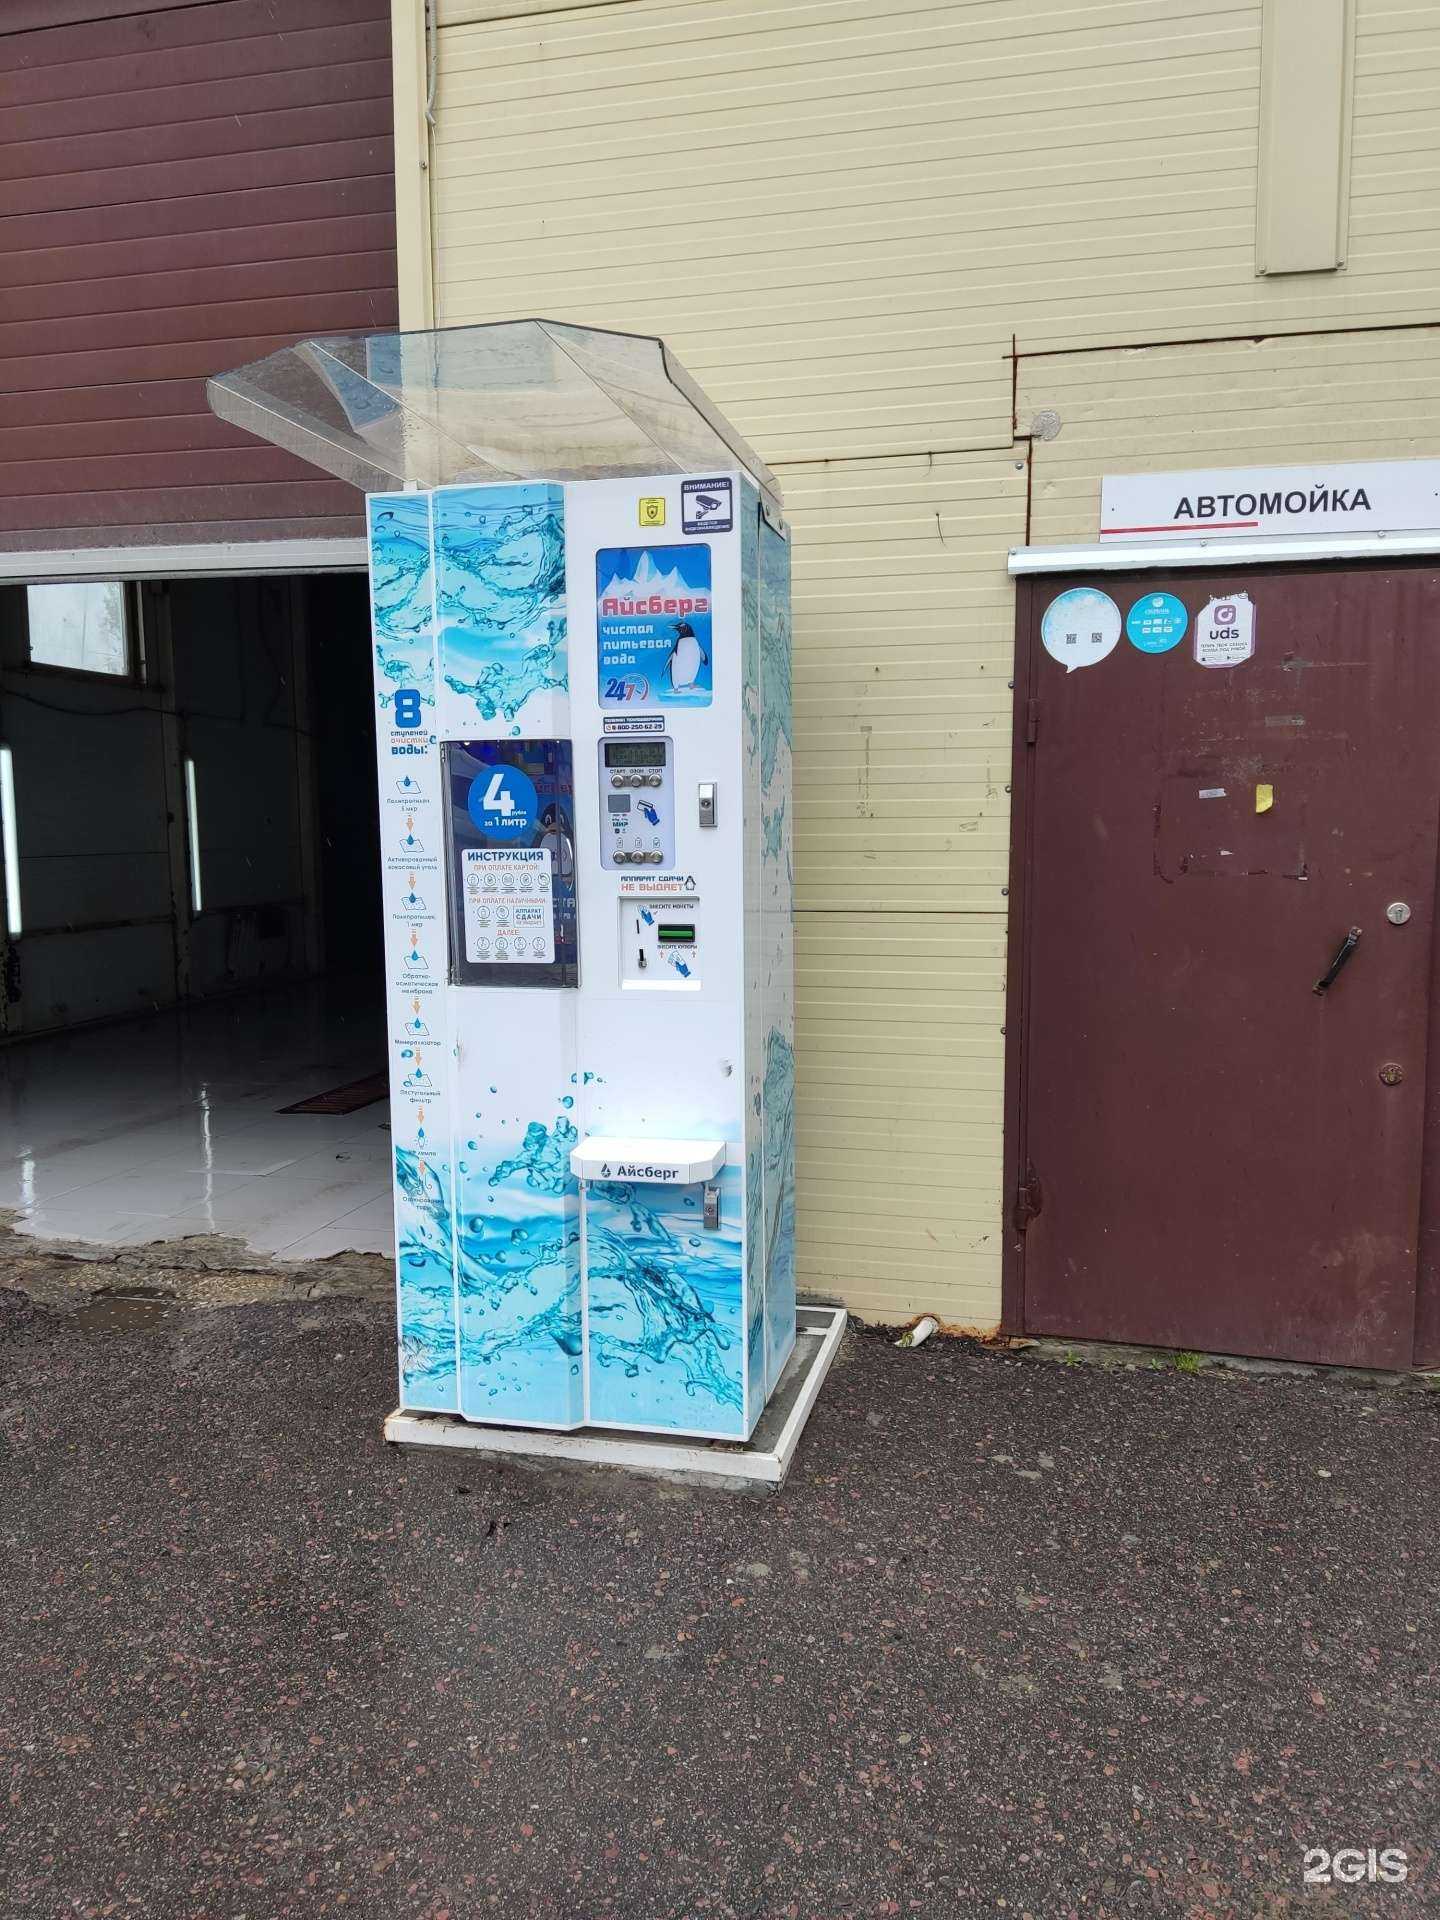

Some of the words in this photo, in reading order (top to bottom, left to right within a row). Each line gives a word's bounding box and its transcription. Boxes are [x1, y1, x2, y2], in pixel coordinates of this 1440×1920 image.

[683, 481, 730, 491] ВНИМАНИЕ!
[1173, 483, 1372, 519] АВТОМОЙКА
[602, 595, 708, 617] Айсберг
[602, 624, 654, 635] чистая
[1209, 627, 1239, 640] uds
[603, 638, 672, 650] питьевая
[603, 652, 636, 665] вода
[395, 689, 422, 728] 8
[390, 729, 428, 737] ступеней
[391, 744, 428, 755] воды:
[483, 773, 515, 817] 4
[494, 817, 500, 826] 1
[501, 817, 528, 828] литр
[467, 851, 544, 862] ИНСТРУКЦИЯ
[621, 883, 635, 891] НЕ
[639, 883, 683, 892] ВЫДАЕТ
[617, 1165, 680, 1180] Айсберг
